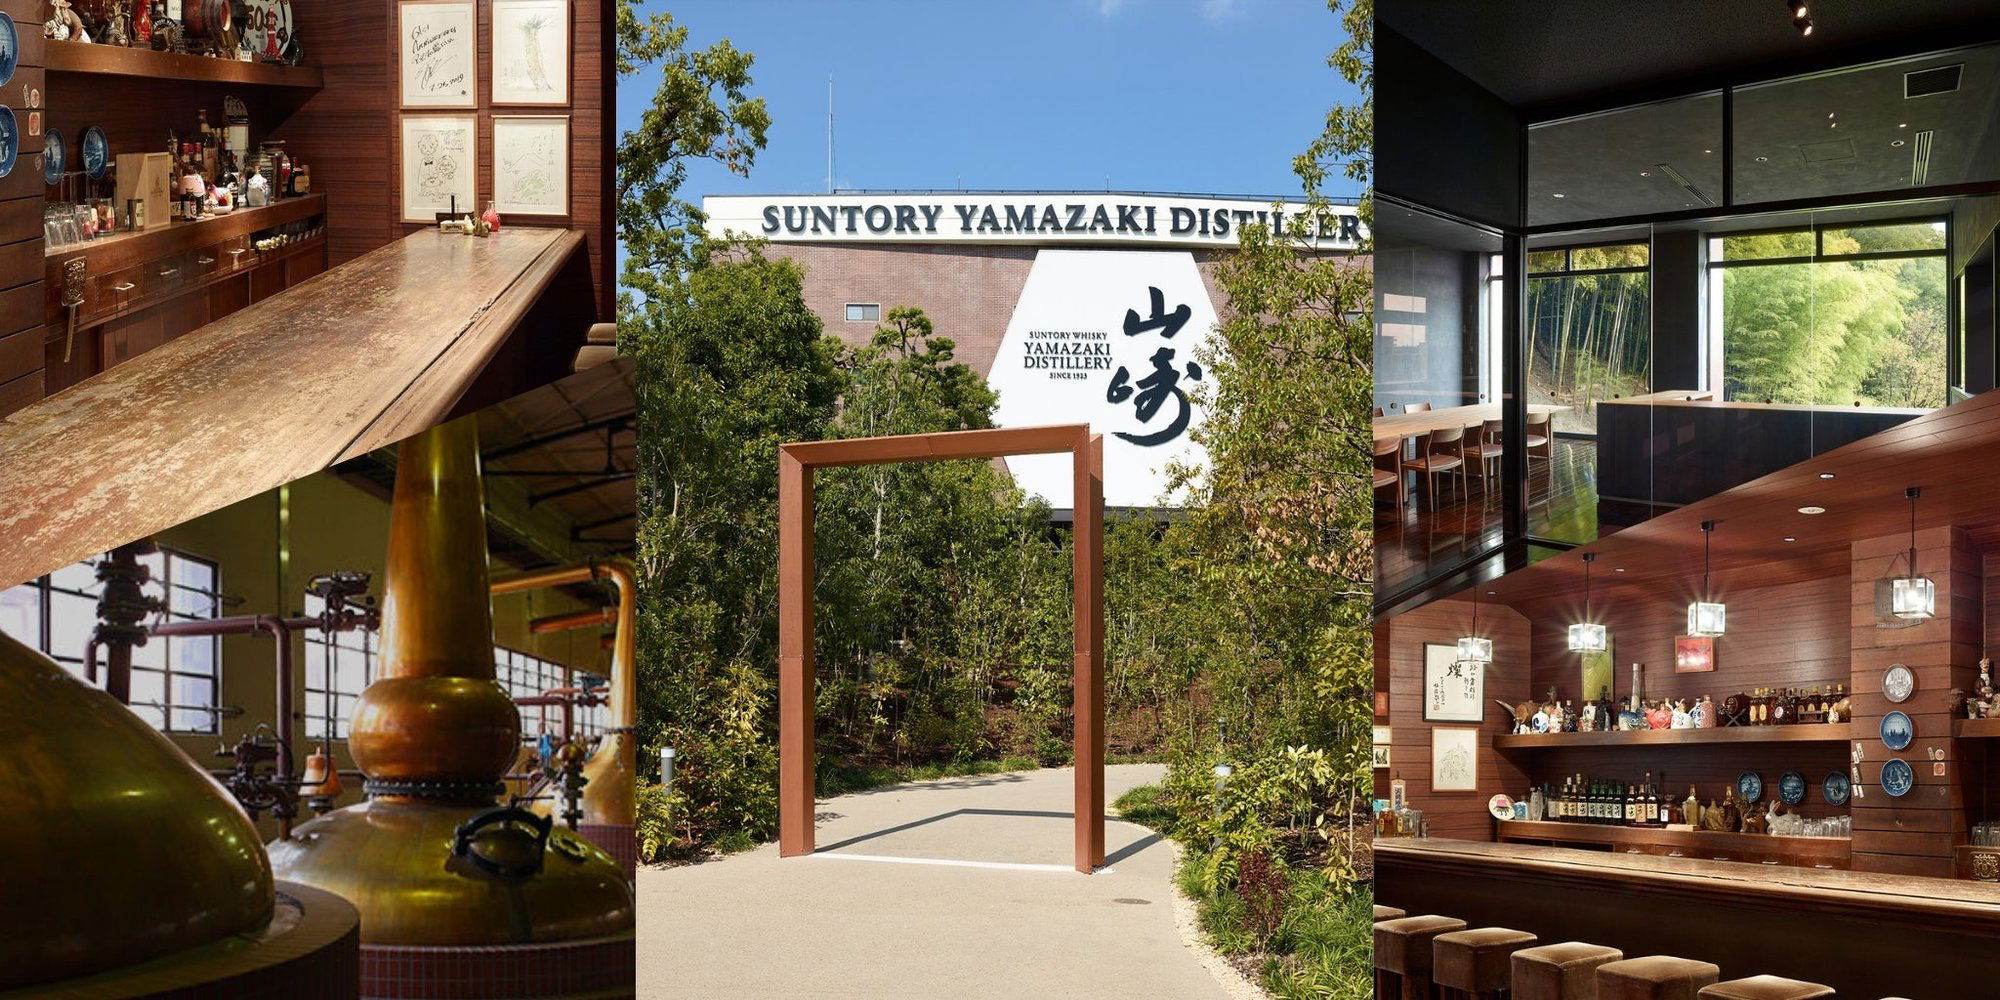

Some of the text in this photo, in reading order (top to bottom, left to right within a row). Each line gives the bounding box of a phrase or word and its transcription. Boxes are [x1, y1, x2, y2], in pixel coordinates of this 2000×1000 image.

[761, 203, 1374, 242] SUNTORY YAMAZAKI DISTILER
[1029, 331, 1108, 341] SUNTORY WHISKY
[1024, 342, 1110, 356] YAMAZAKI
[1024, 356, 1113, 370] DISTILLERY
[1049, 372, 1088, 380] SINCE 1923
